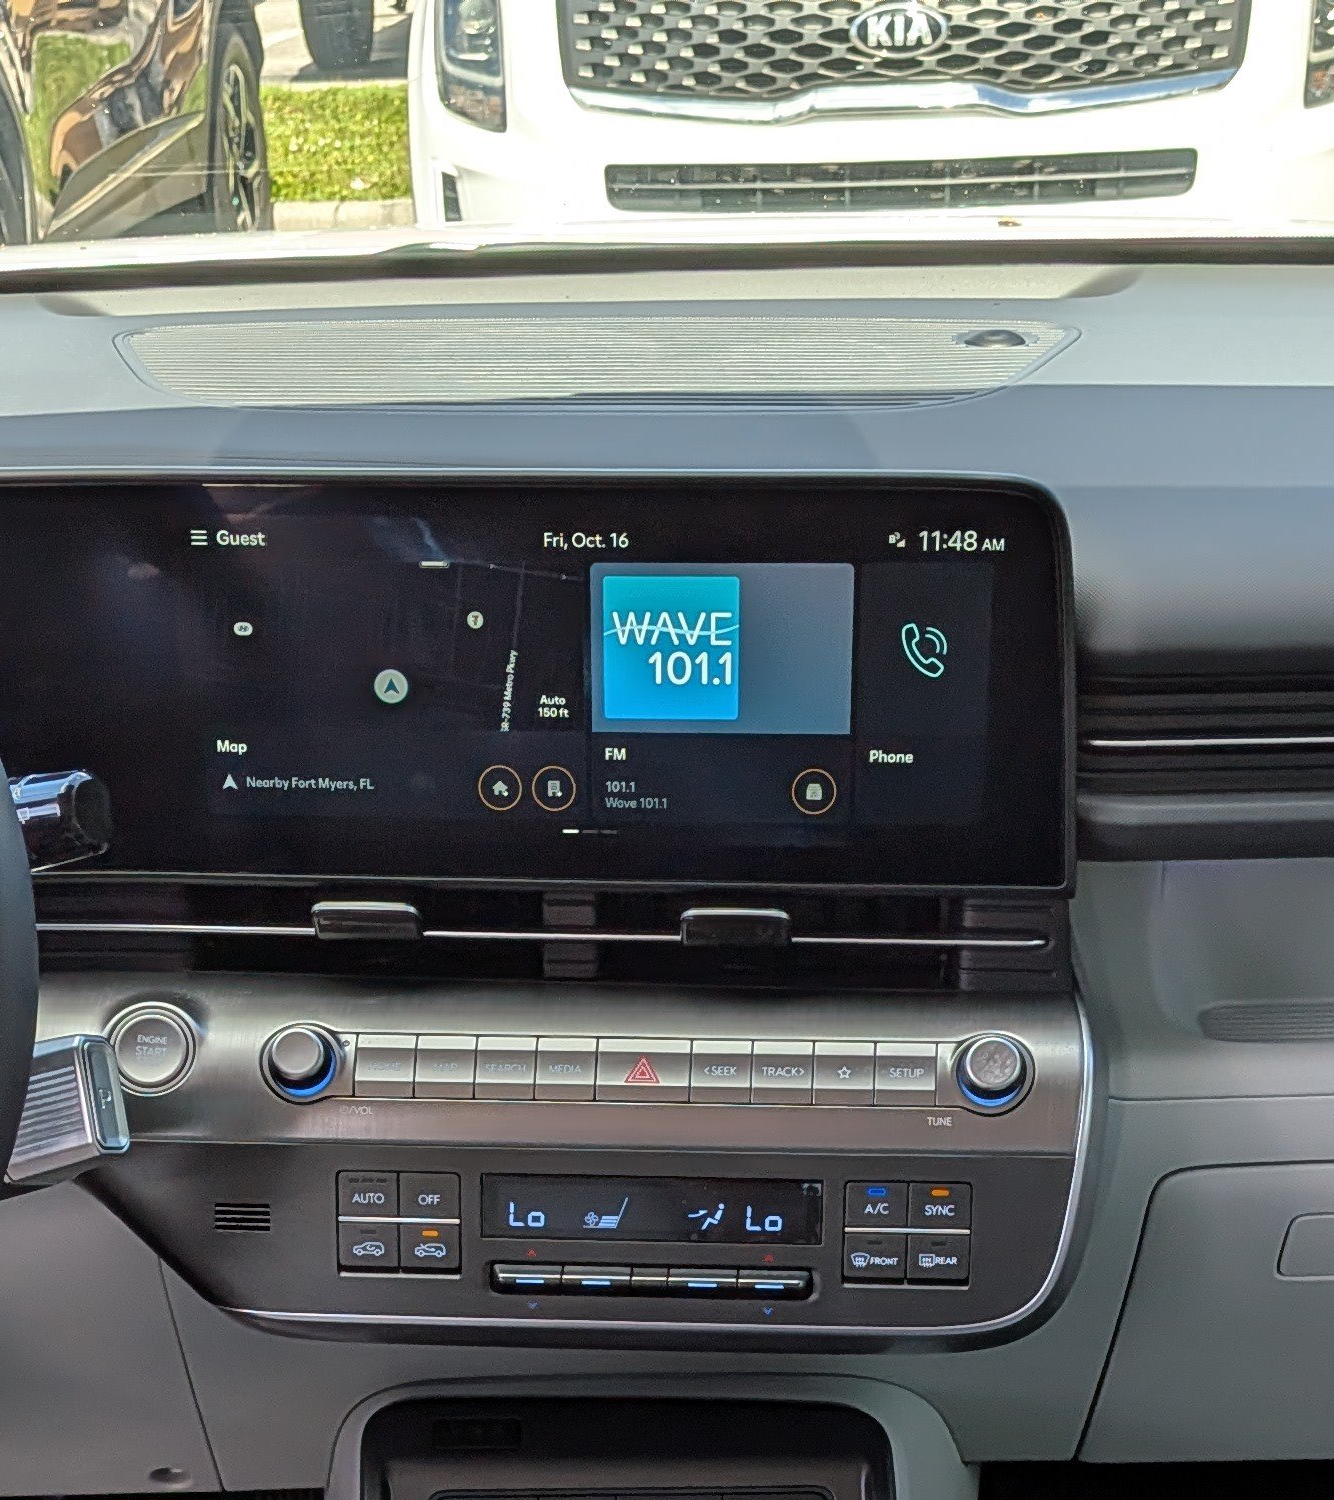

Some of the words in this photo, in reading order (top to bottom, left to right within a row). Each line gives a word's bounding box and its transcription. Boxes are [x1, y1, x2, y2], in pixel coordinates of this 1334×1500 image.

[865, 10, 936, 47] KIA
[216, 530, 265, 547] Guest
[543, 532, 567, 549] Fri,
[572, 533, 606, 548] Oct.
[610, 533, 629, 548] 16
[919, 530, 978, 551] 11:48
[982, 538, 1005, 551] AM
[611, 611, 733, 646] WAVE
[648, 651, 733, 686] 101.1
[540, 695, 566, 706] Auto
[538, 707, 555, 718] 150
[557, 707, 569, 718] ft
[217, 740, 247, 755] Map
[605, 748, 627, 761] FM
[869, 750, 913, 764] Phone
[246, 776, 289, 791] Nearby
[291, 777, 316, 790] Fort
[318, 777, 358, 791] Myers,
[360, 778, 374, 790] FL
[605, 781, 636, 793] 101.1
[605, 797, 637, 810] Wave
[639, 797, 668, 810] 101.1
[137, 1034, 167, 1045] ENGINE
[135, 1046, 167, 1057] START
[484, 1063, 527, 1074] SEARCH
[548, 1064, 582, 1075] MEDIA
[889, 1067, 925, 1078] SETUP
[927, 1116, 953, 1127] TUNE
[352, 1192, 385, 1204] AUTO
[418, 1193, 441, 1206] OFF
[509, 1202, 545, 1228] Lo
[864, 1202, 889, 1216] A/C
[924, 1204, 955, 1217] SYNC
[745, 1205, 783, 1232] Lo
[870, 1256, 898, 1267] FRONT
[935, 1256, 957, 1267] REAR
